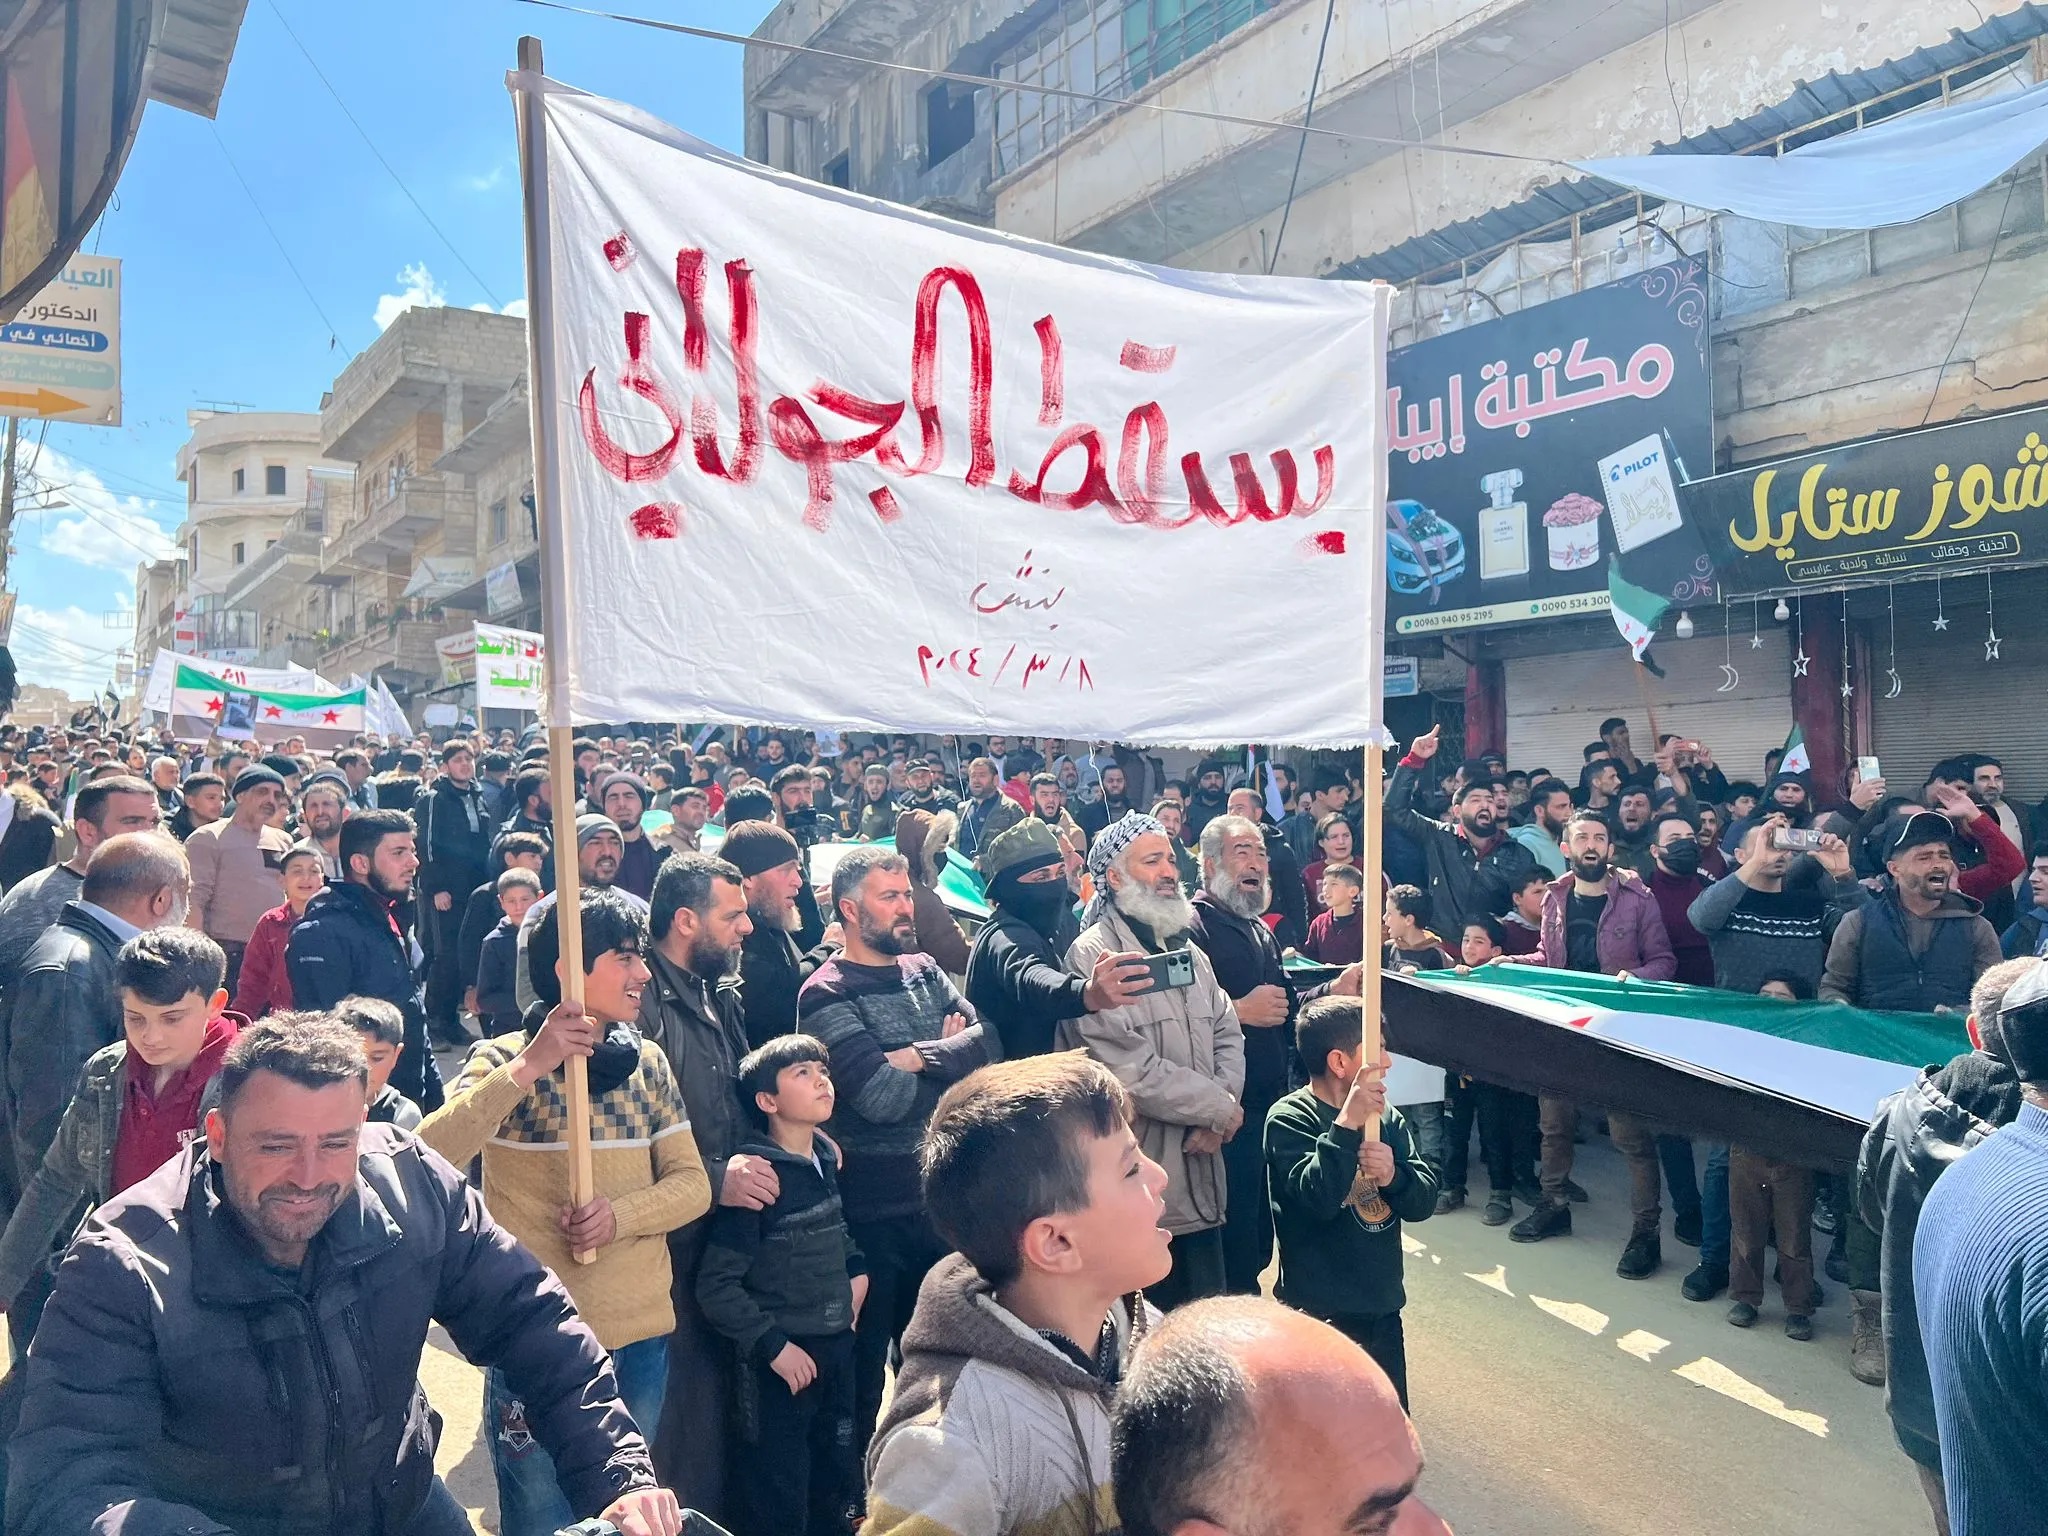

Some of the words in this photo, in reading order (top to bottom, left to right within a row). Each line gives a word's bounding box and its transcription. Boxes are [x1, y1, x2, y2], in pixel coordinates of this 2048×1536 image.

[54, 267, 113, 291] العيا
[9, 328, 36, 343] في
[579, 230, 995, 541] الجولاني
[1474, 338, 1675, 438] مكتبة
[1387, 374, 1466, 464] إيبل
[1007, 313, 1345, 554] يسقط
[1624, 452, 1659, 476] PILOT
[1904, 432, 2048, 540] شوز
[1729, 463, 1900, 561] ستايل
[1931, 545, 1970, 560] وحقائب
[1979, 536, 2008, 553] أحذية
[1541, 601, 1567, 612] 0090
[1569, 598, 1588, 609] 534
[1590, 595, 1610, 606] 300
[1414, 616, 1439, 628] 00963
[1441, 614, 1458, 624] 940
[1461, 613, 1471, 622] 95
[1474, 610, 1493, 620] 2195
